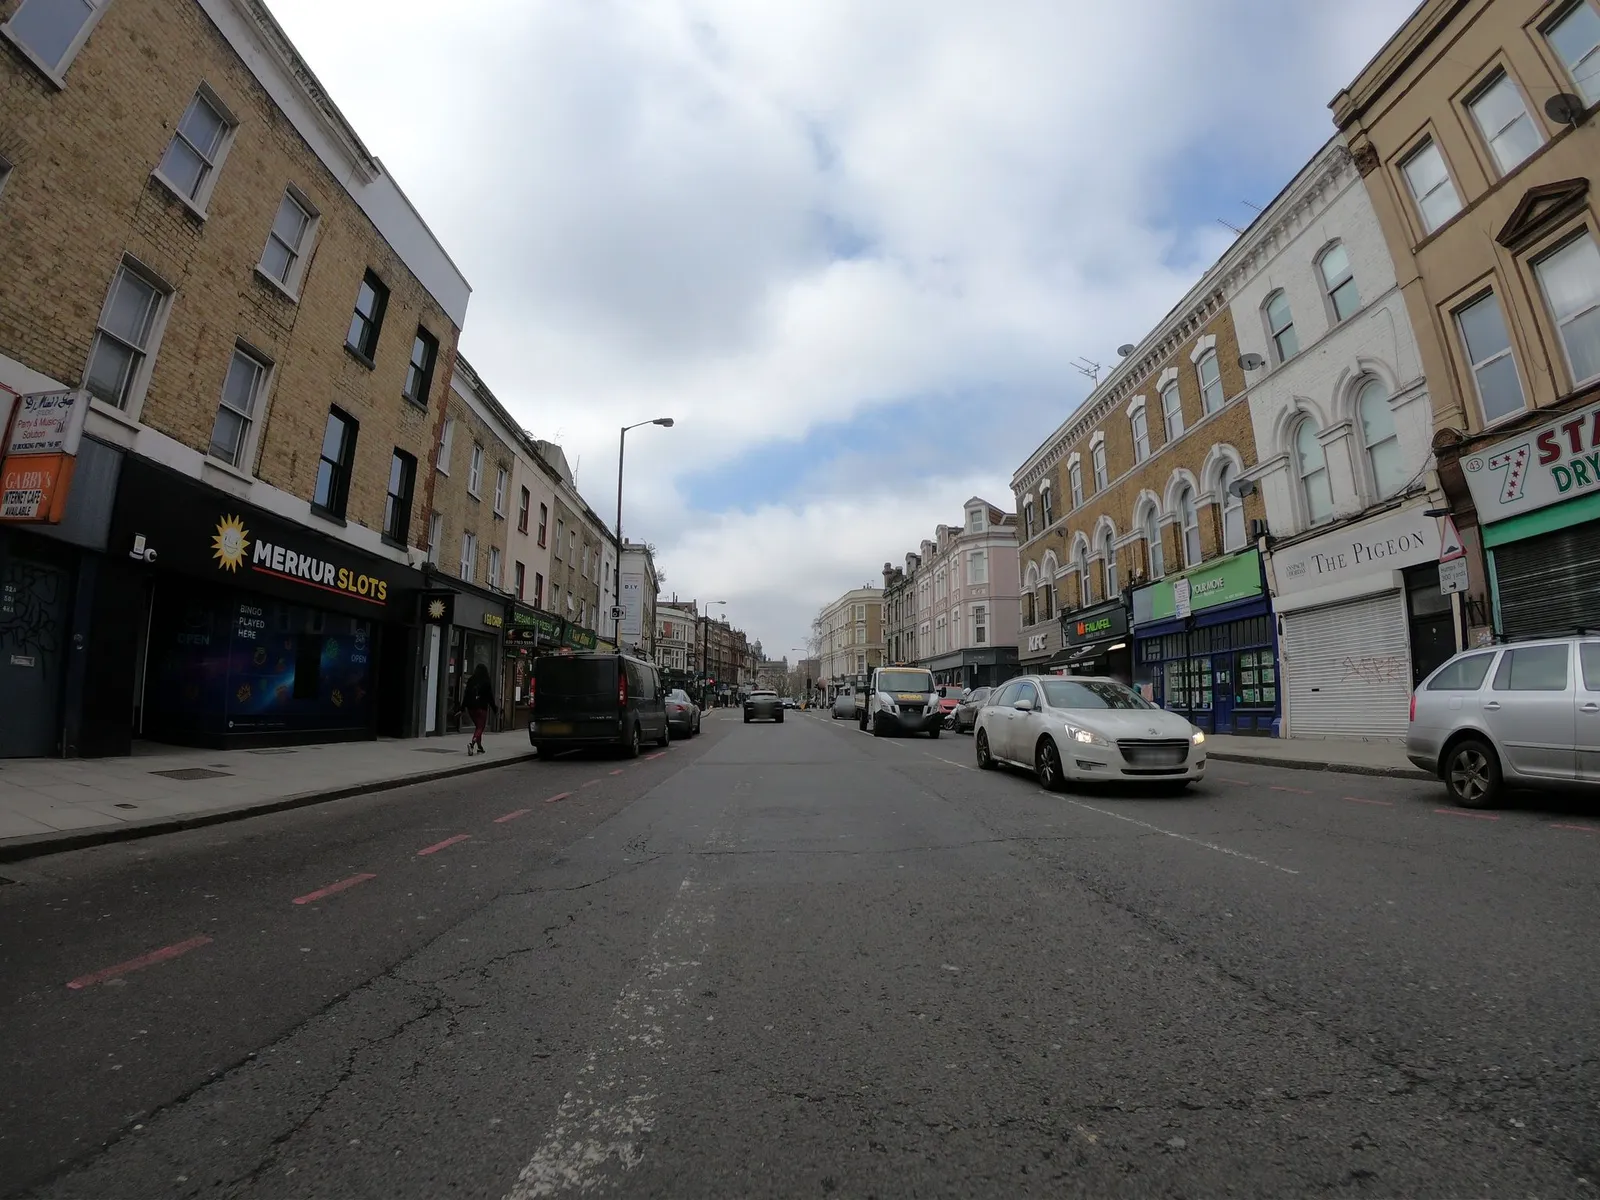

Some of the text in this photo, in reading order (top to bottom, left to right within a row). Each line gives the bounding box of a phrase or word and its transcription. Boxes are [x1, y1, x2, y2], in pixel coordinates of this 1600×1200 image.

[33, 418, 37, 427] &
[39, 417, 57, 427] Music
[22, 430, 46, 440] Solution
[1469, 460, 1481, 471] 43
[1488, 443, 1531, 504] 7
[4, 506, 31, 516] AVAILABLE
[252, 539, 387, 600] MERKUR SLOTS
[240, 605, 263, 616] BINGO
[239, 617, 265, 629] PLAYED
[1085, 618, 1112, 634] FALAFEL
[177, 633, 210, 646] OPEN
[238, 629, 256, 640] HERE
[1027, 633, 1048, 652] KFC
[351, 654, 367, 664] OPEN
